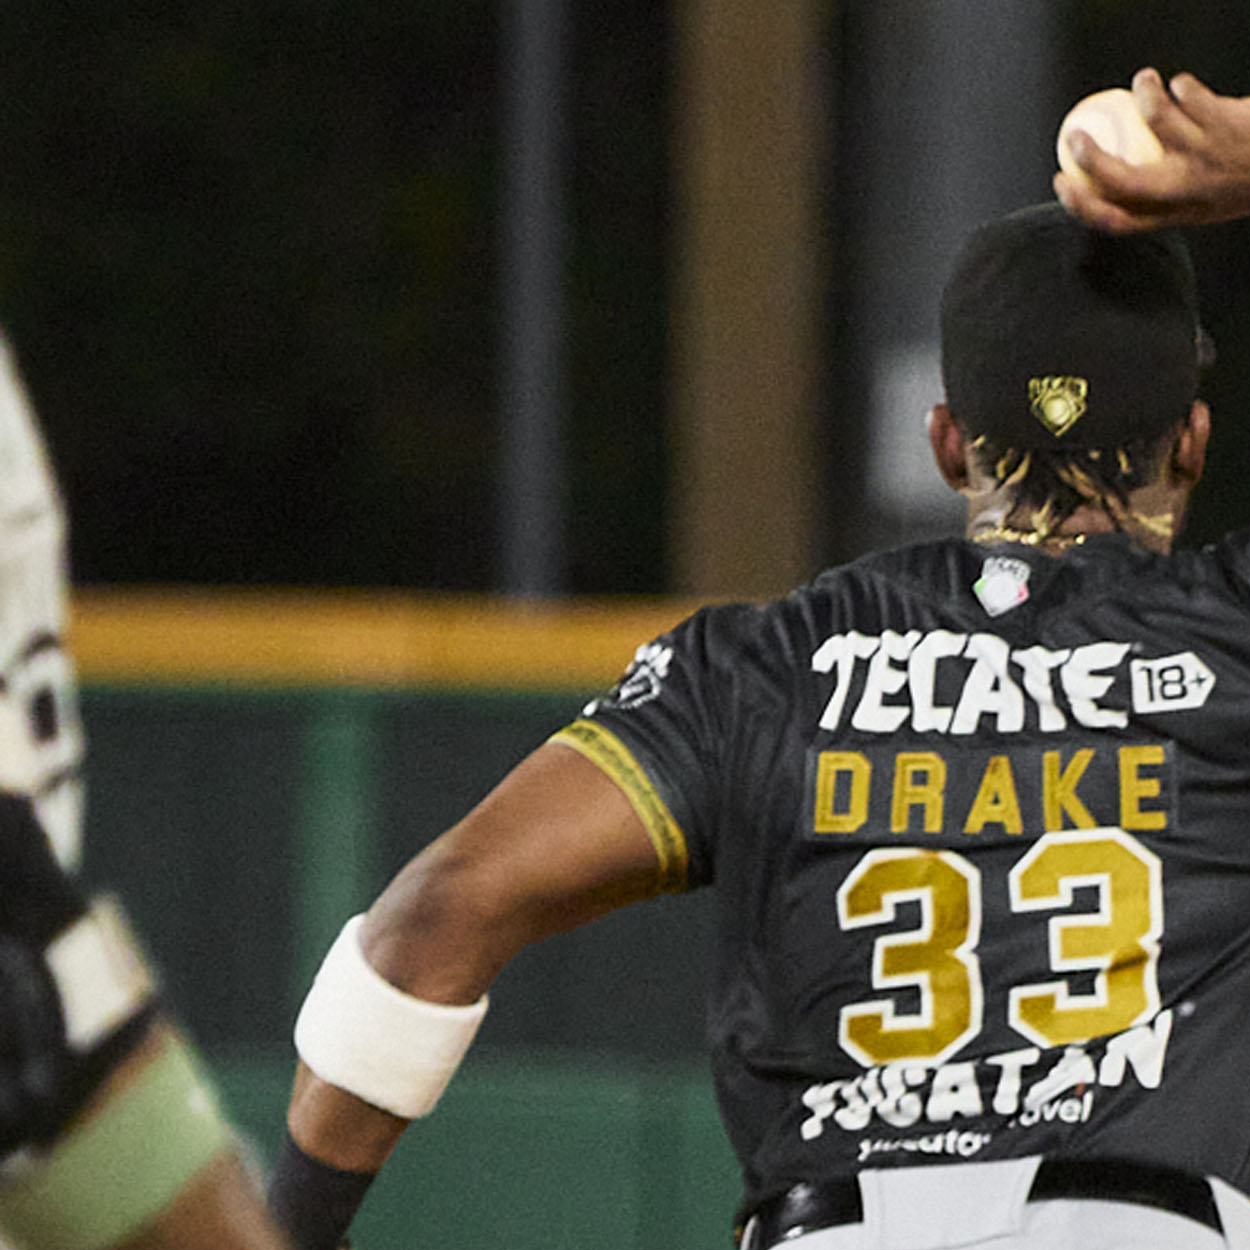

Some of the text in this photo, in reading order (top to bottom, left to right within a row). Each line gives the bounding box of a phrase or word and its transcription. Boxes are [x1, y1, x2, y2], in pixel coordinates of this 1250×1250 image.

[811, 629, 1211, 735] TECATE 18+
[813, 744, 1168, 835] DRAKE
[836, 826, 1165, 1069] 33
